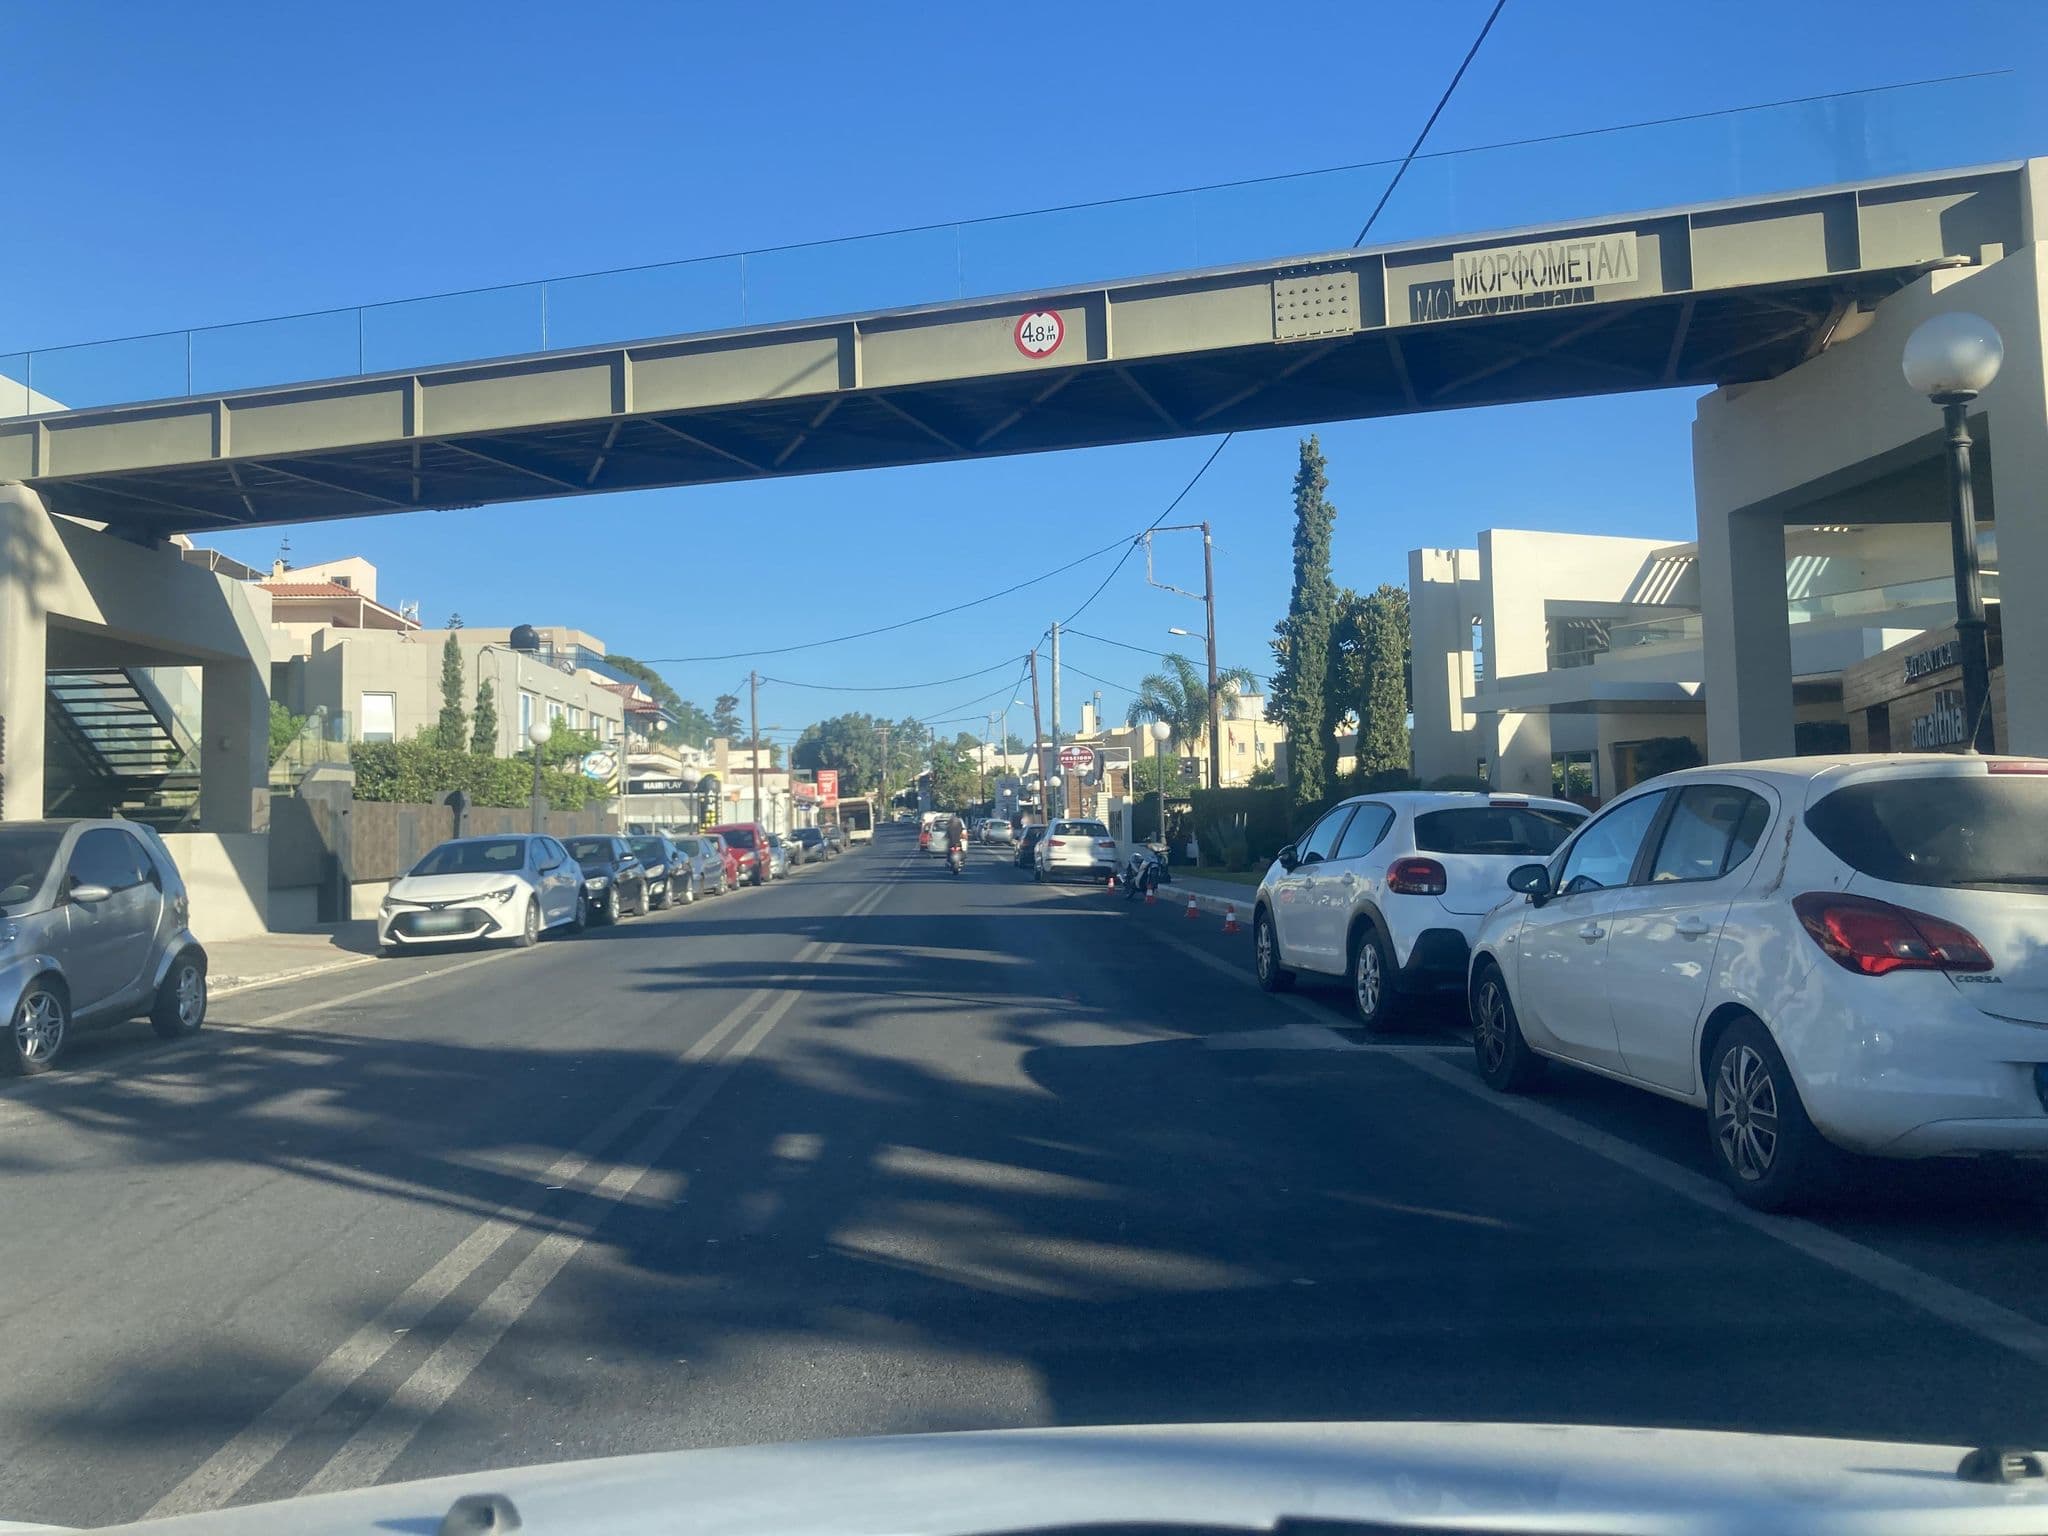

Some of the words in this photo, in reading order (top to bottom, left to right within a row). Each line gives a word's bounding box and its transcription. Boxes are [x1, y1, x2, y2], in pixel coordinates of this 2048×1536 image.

[1460, 239, 1632, 295] ΜΟΡΦΟΜΕΤΑΛ
[1022, 322, 1045, 342] 4.8
[1911, 691, 1962, 749] amalthia
[1955, 975, 2003, 984] CORSA
